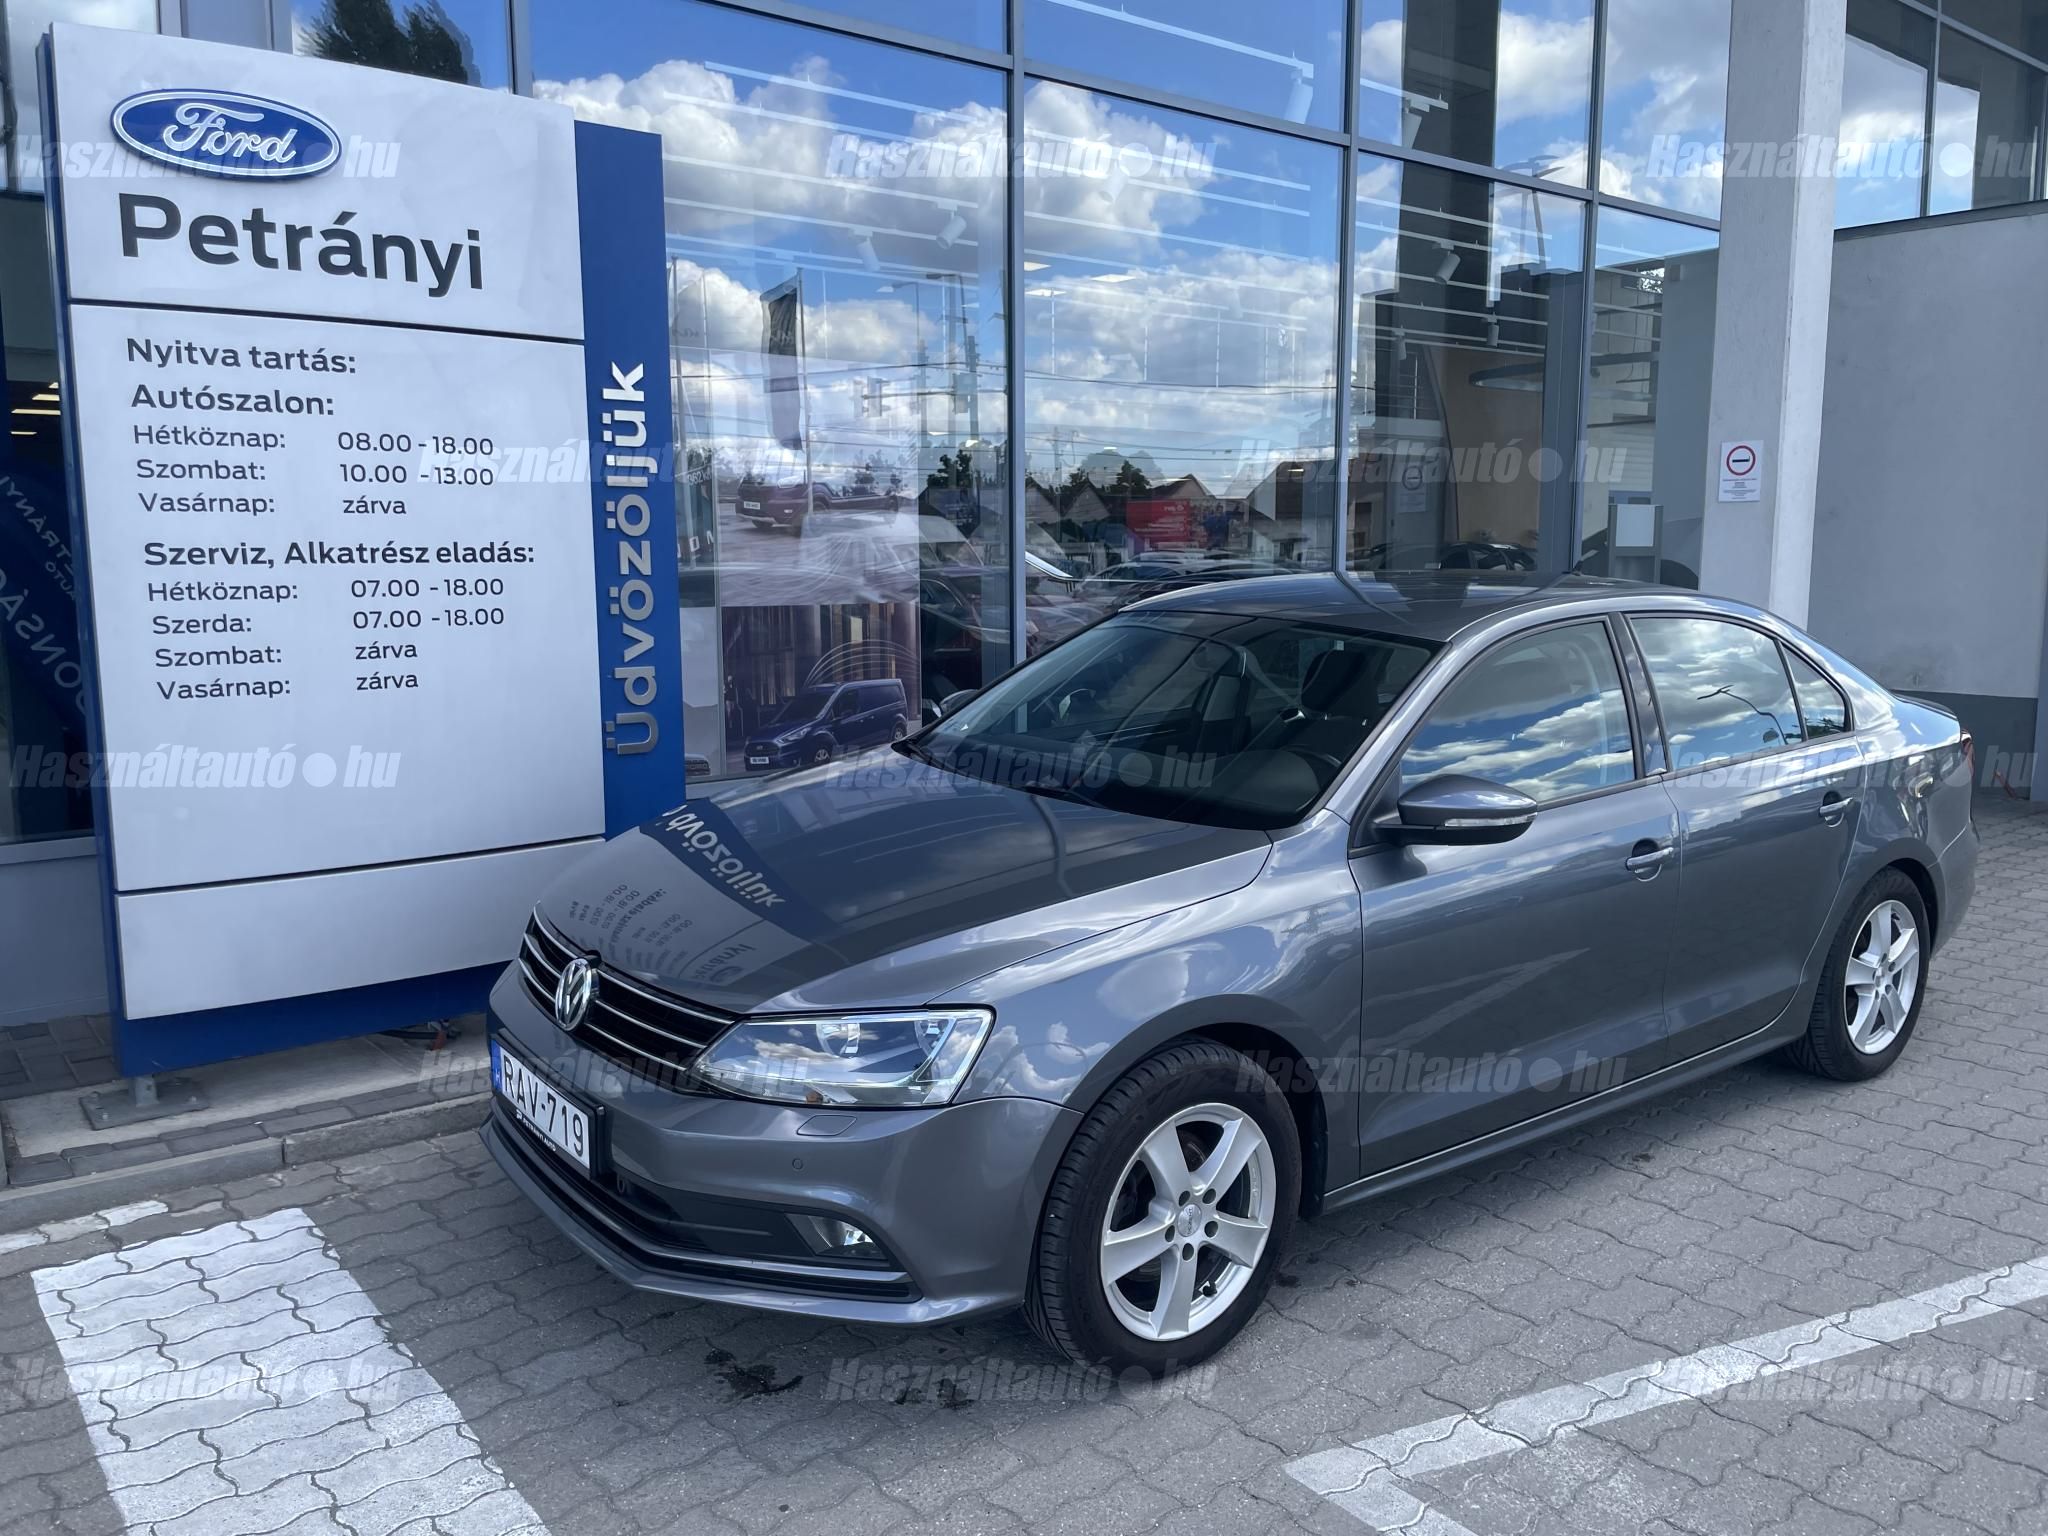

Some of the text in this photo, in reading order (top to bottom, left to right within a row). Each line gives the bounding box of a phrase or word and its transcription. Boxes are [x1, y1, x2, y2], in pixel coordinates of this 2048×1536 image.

[163, 102, 298, 163] Ford
[118, 192, 483, 298] Petrányi
[126, 338, 356, 374] Nyitva tartás:
[131, 384, 334, 416] Autószalon:
[133, 425, 286, 451] Hétköznap:
[338, 432, 412, 452] 08.00
[136, 459, 266, 481] Szombat:
[340, 463, 407, 484] 10.00
[138, 492, 407, 517] Vasárnap: zárva
[144, 541, 535, 569] Szerviz, Alkatrész eladás:
[602, 361, 660, 755] Üdvözöljük
[148, 581, 298, 603] Hétköznap:
[351, 579, 420, 598] 07.00
[152, 614, 252, 635] Szerda:
[353, 610, 422, 629] 07.00
[155, 641, 418, 668] Szombat: zárva
[156, 672, 419, 700] Vasárnap: zárva
[503, 1054, 584, 1158] RAV-719
